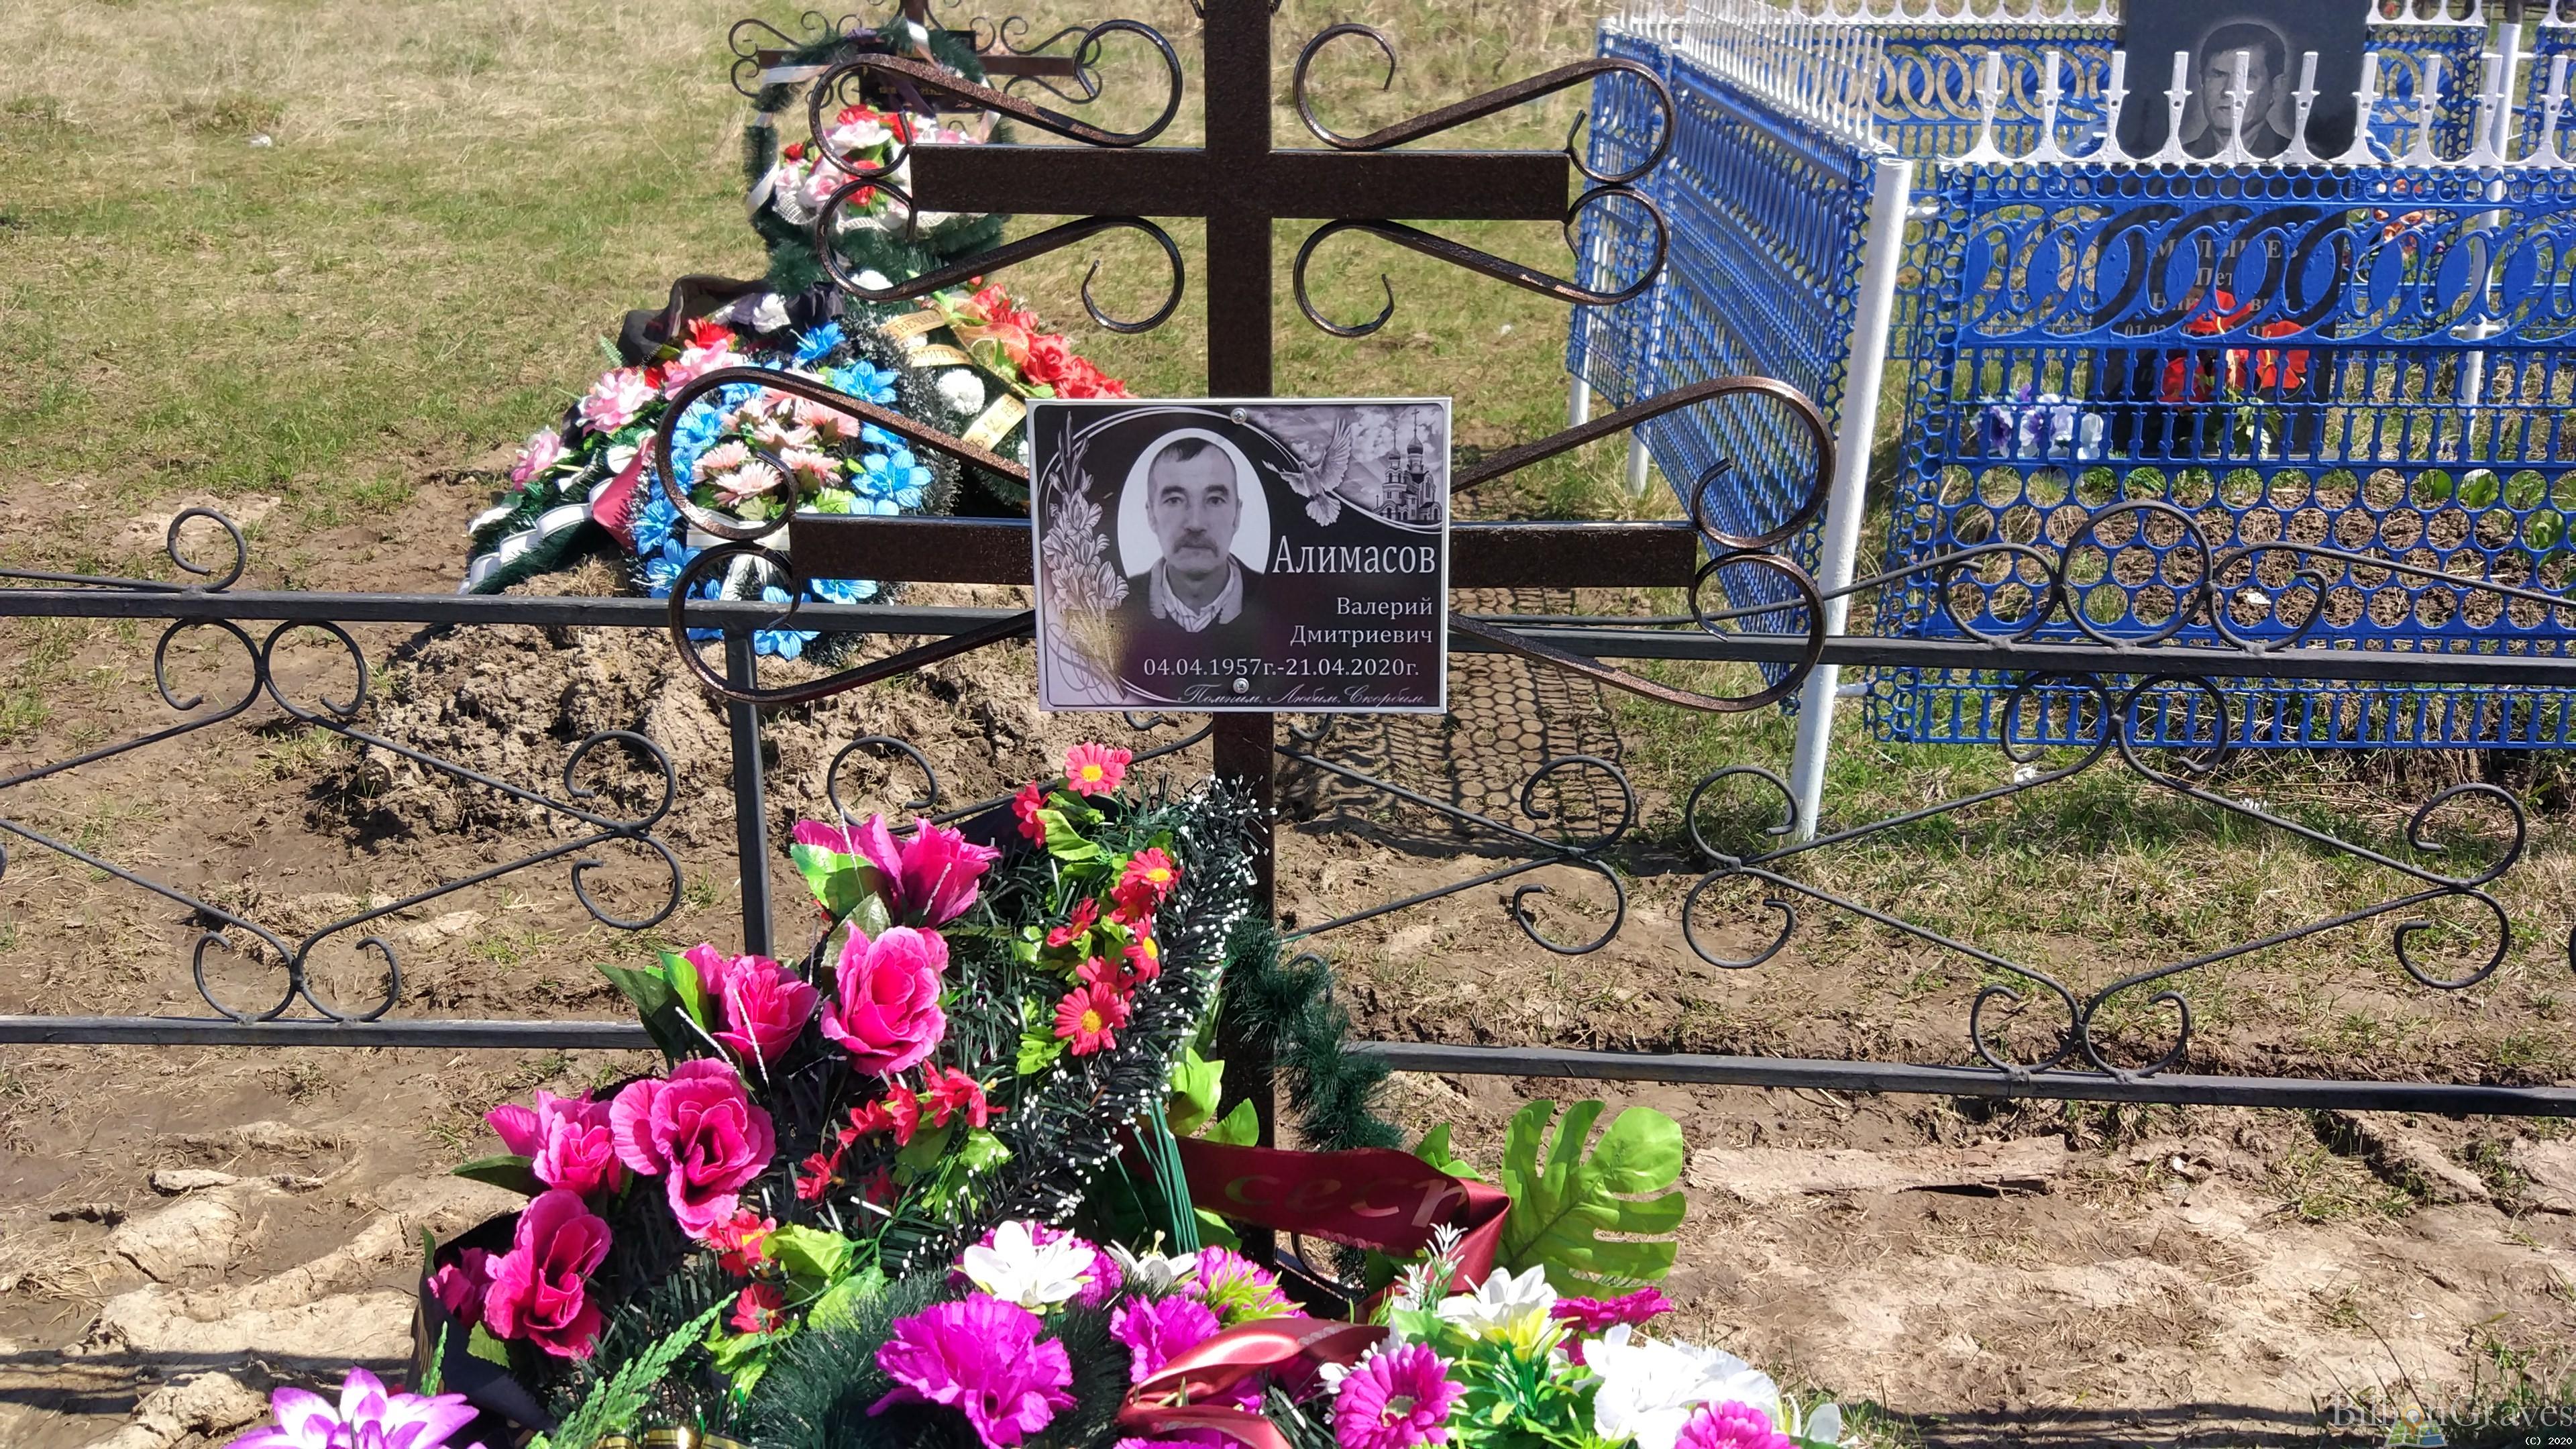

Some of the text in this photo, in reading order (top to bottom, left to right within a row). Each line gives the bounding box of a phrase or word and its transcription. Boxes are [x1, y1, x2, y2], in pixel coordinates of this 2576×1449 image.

[1272, 535, 1436, 574] Алимасов
[1336, 597, 1433, 620] Валерий
[1290, 625, 1433, 648] Дмитриевич
[1178, 683, 1426, 708] Помним. Любим. Скорбим.
